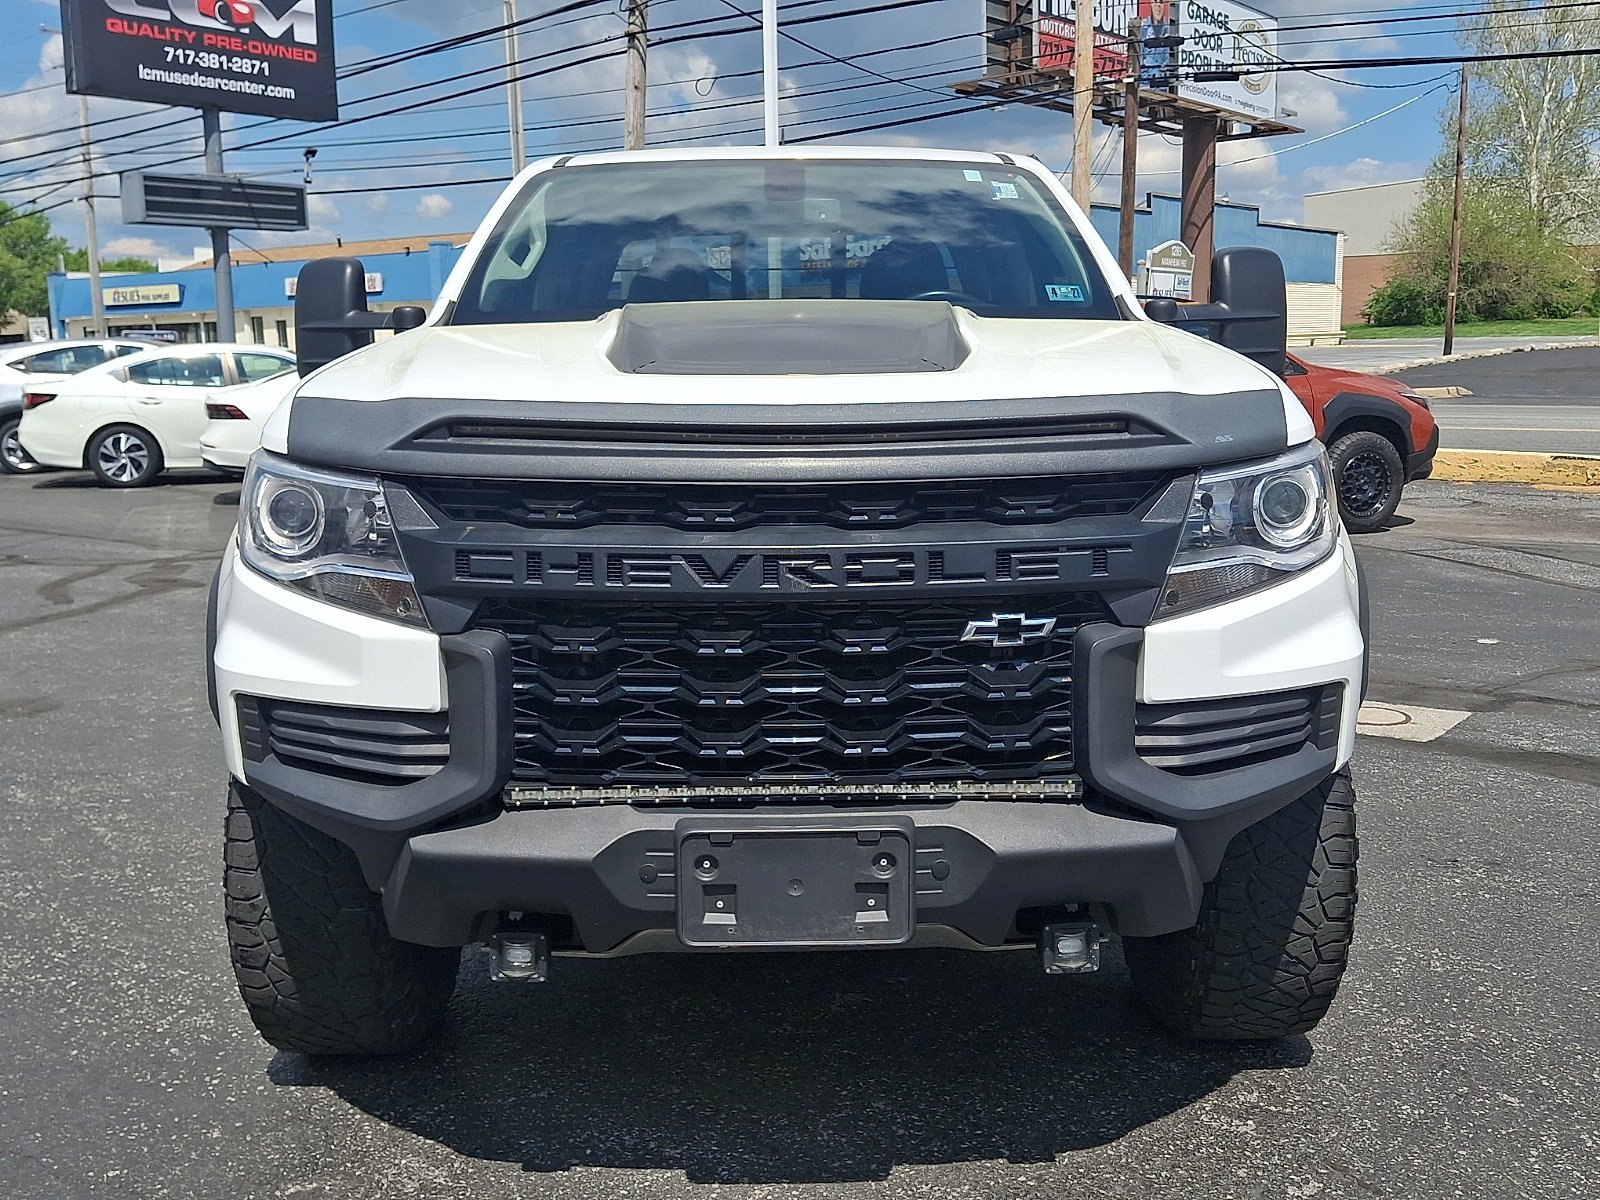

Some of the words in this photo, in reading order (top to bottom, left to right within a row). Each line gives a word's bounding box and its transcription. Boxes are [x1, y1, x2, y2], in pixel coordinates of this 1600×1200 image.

[1187, 0, 1230, 32] GARAGE
[105, 17, 197, 45] QUALITY
[203, 32, 318, 63] PRE-OWNED
[1194, 27, 1223, 54] DOOR
[1232, 36, 1274, 71] Precision
[163, 46, 270, 77] 717-381-2871
[138, 63, 295, 100] lcmusedcarcenter.com
[1051, 287, 1058, 298] 4
[452, 545, 1133, 589] CHEVROLET
